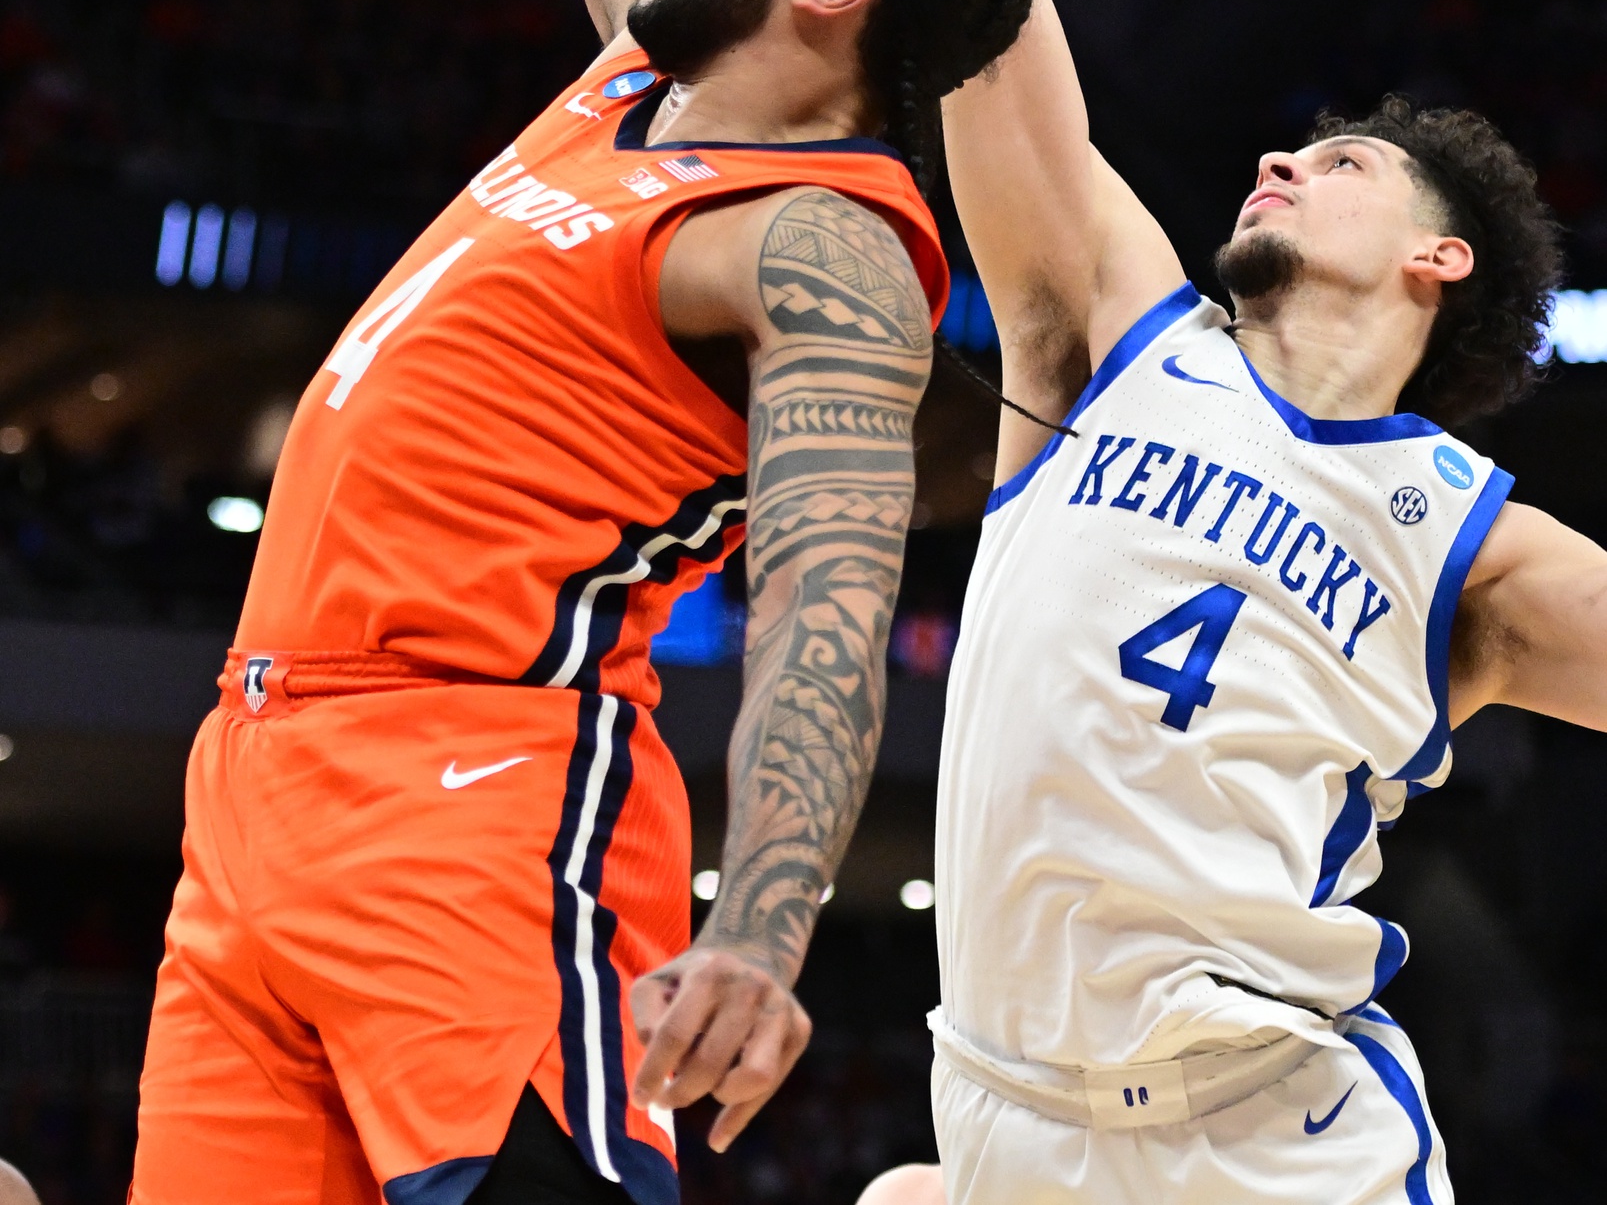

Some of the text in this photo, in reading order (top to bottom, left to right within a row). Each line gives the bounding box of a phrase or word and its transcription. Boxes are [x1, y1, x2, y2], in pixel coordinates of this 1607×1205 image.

[325, 238, 475, 410] 4
[1392, 487, 1427, 524] SEC
[1438, 455, 1470, 486] NCAA
[1068, 435, 1391, 661] KENTUCKY
[1118, 583, 1247, 732] 4
